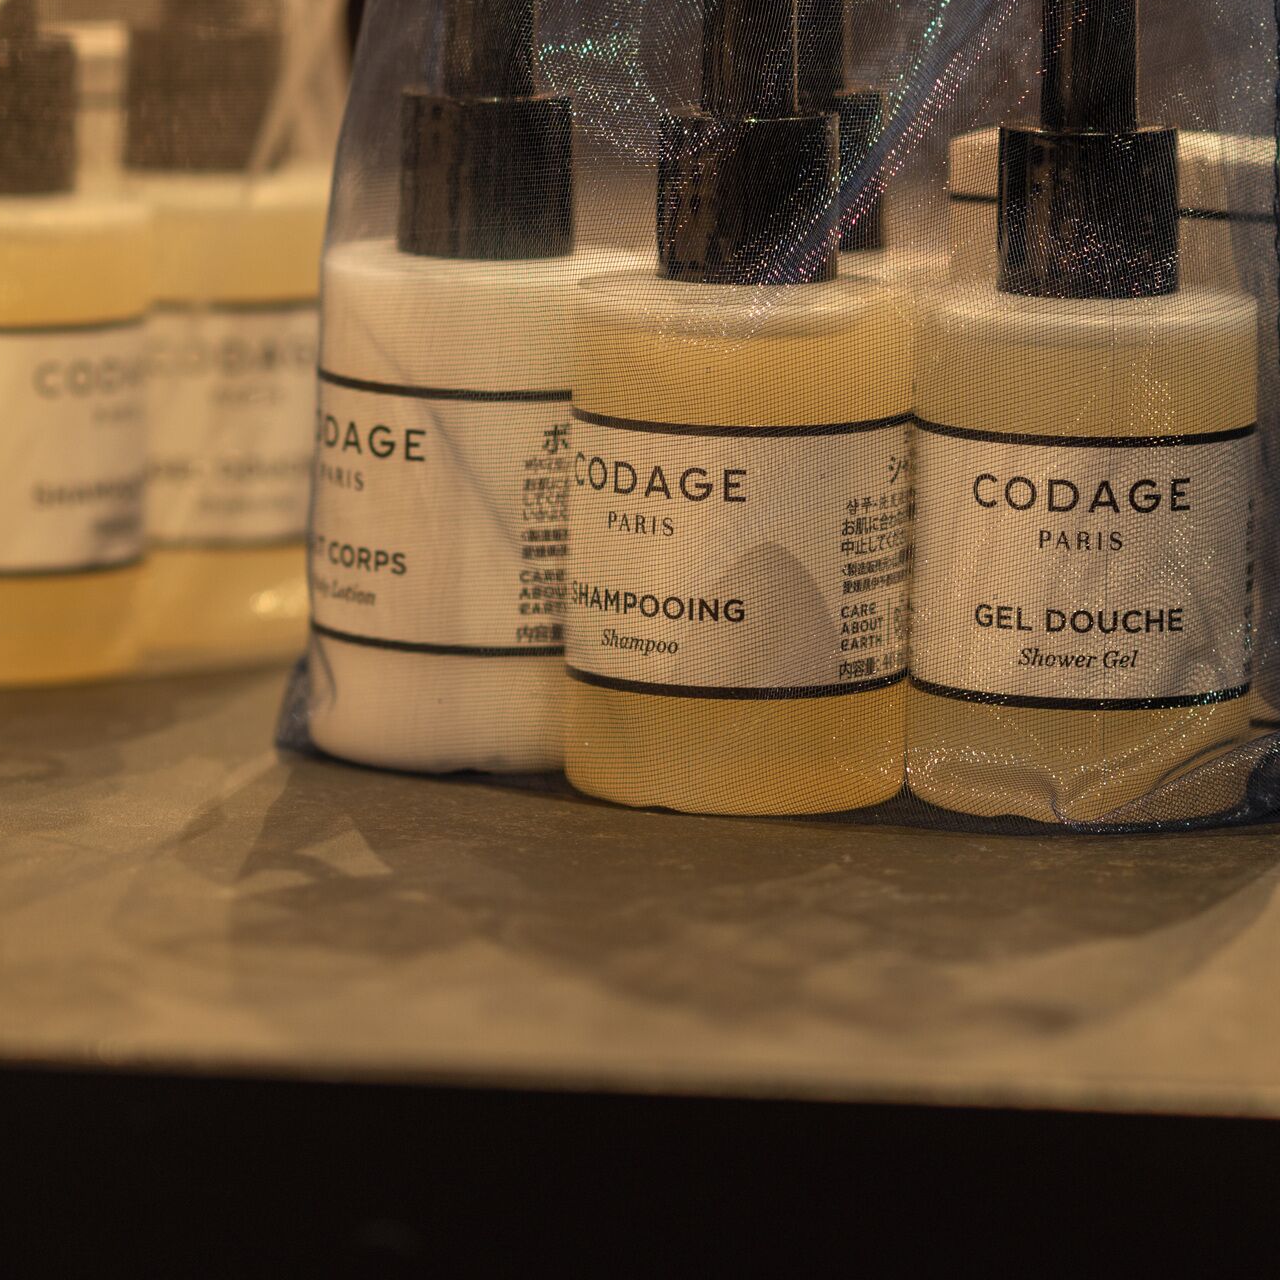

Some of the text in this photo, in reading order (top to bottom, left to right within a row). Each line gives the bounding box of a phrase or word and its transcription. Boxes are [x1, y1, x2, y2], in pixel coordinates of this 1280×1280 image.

[573, 451, 748, 503] CODAGE
[972, 472, 1192, 514] CODAGE
[607, 511, 675, 537] PARIS
[1038, 529, 1124, 551] PARIS
[328, 540, 407, 576] CORPS
[572, 579, 747, 623] SHAMPOOING
[975, 603, 1184, 634] GEL DOUCHE
[601, 628, 679, 657] Shampoo
[1018, 646, 1139, 670] Shower Gel
